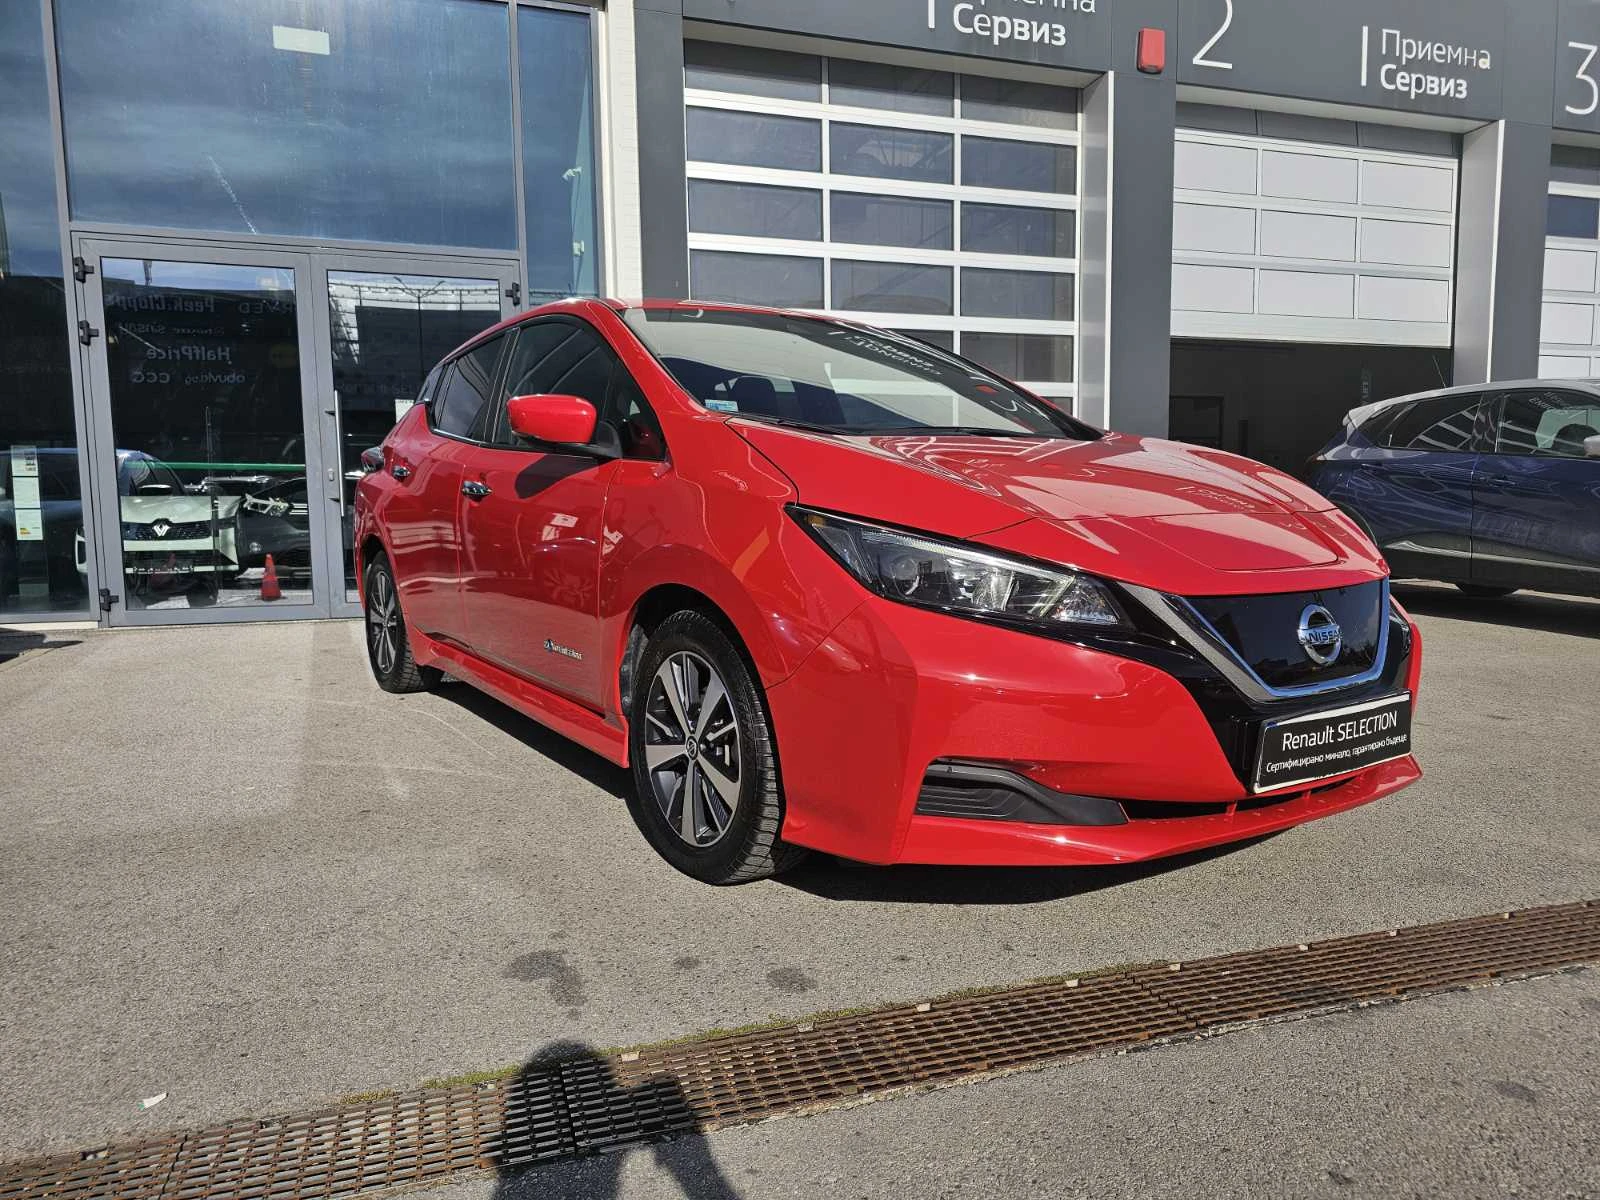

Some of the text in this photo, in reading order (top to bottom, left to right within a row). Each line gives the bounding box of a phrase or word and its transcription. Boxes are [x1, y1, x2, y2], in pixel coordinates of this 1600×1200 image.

[953, 2, 1067, 46] Сервиз
[1192, 0, 1233, 70] 2
[1382, 28, 1491, 69] Приемна
[1380, 63, 1468, 99] Сервиз
[1565, 41, 1599, 115] 3
[1282, 710, 1397, 751] Renault SELECTION
